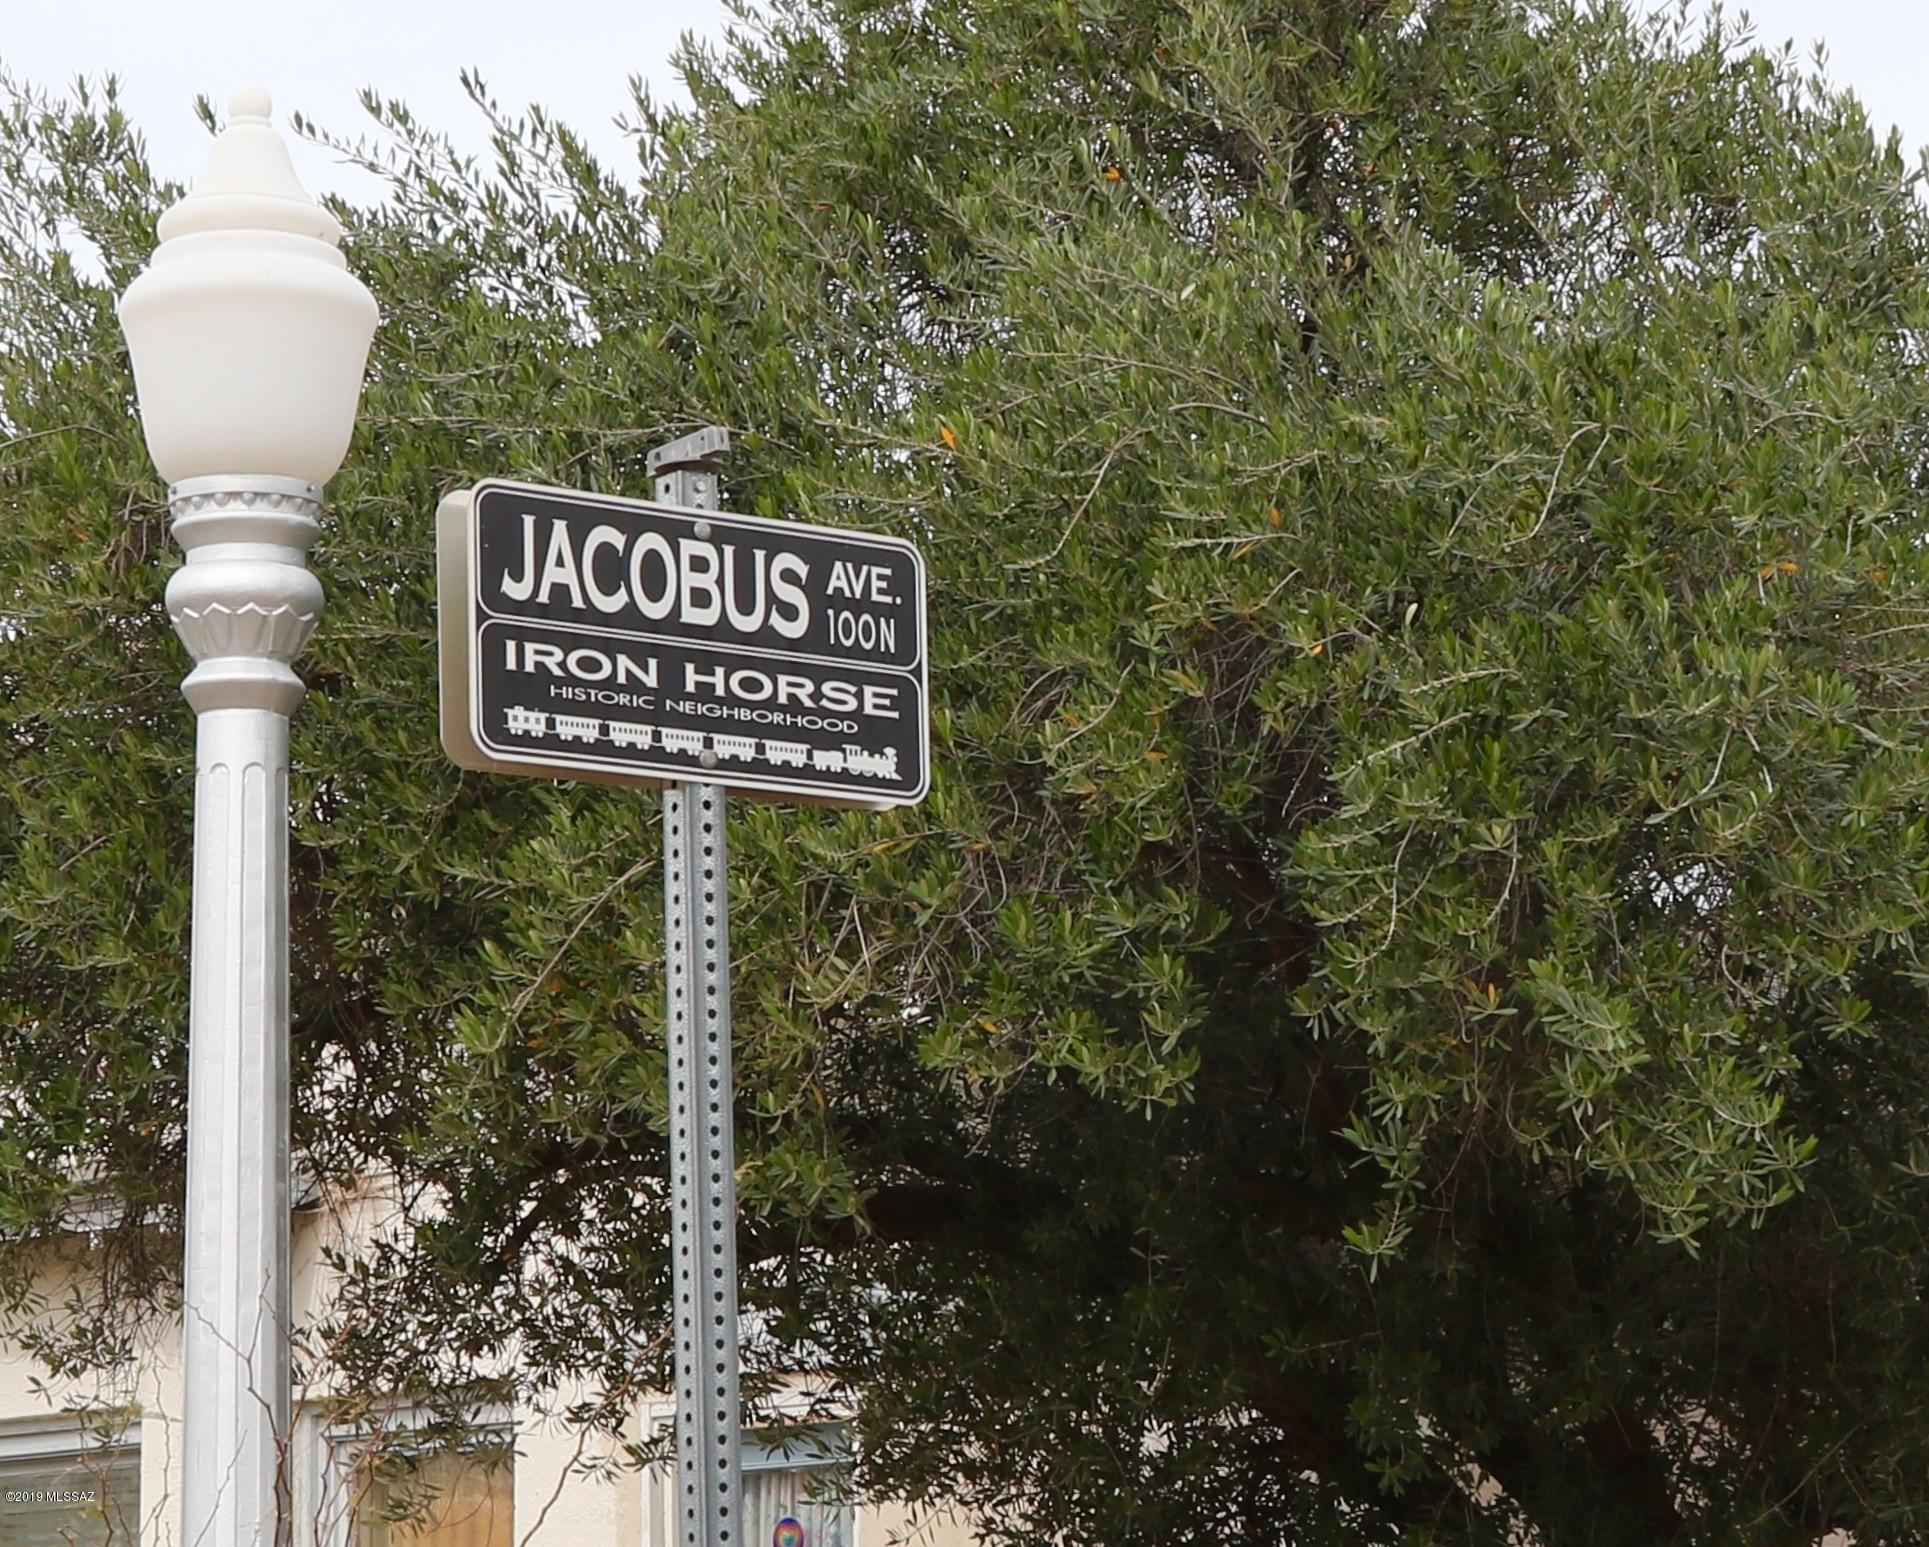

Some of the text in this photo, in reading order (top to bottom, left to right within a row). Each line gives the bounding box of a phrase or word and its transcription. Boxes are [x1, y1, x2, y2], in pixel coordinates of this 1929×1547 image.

[500, 514, 902, 639] JACOBUS AVE.
[826, 608, 896, 654] 100N
[504, 639, 900, 720] IRON HORSE
[550, 684, 859, 734] HISTORIC NEIGHBORHOOD
